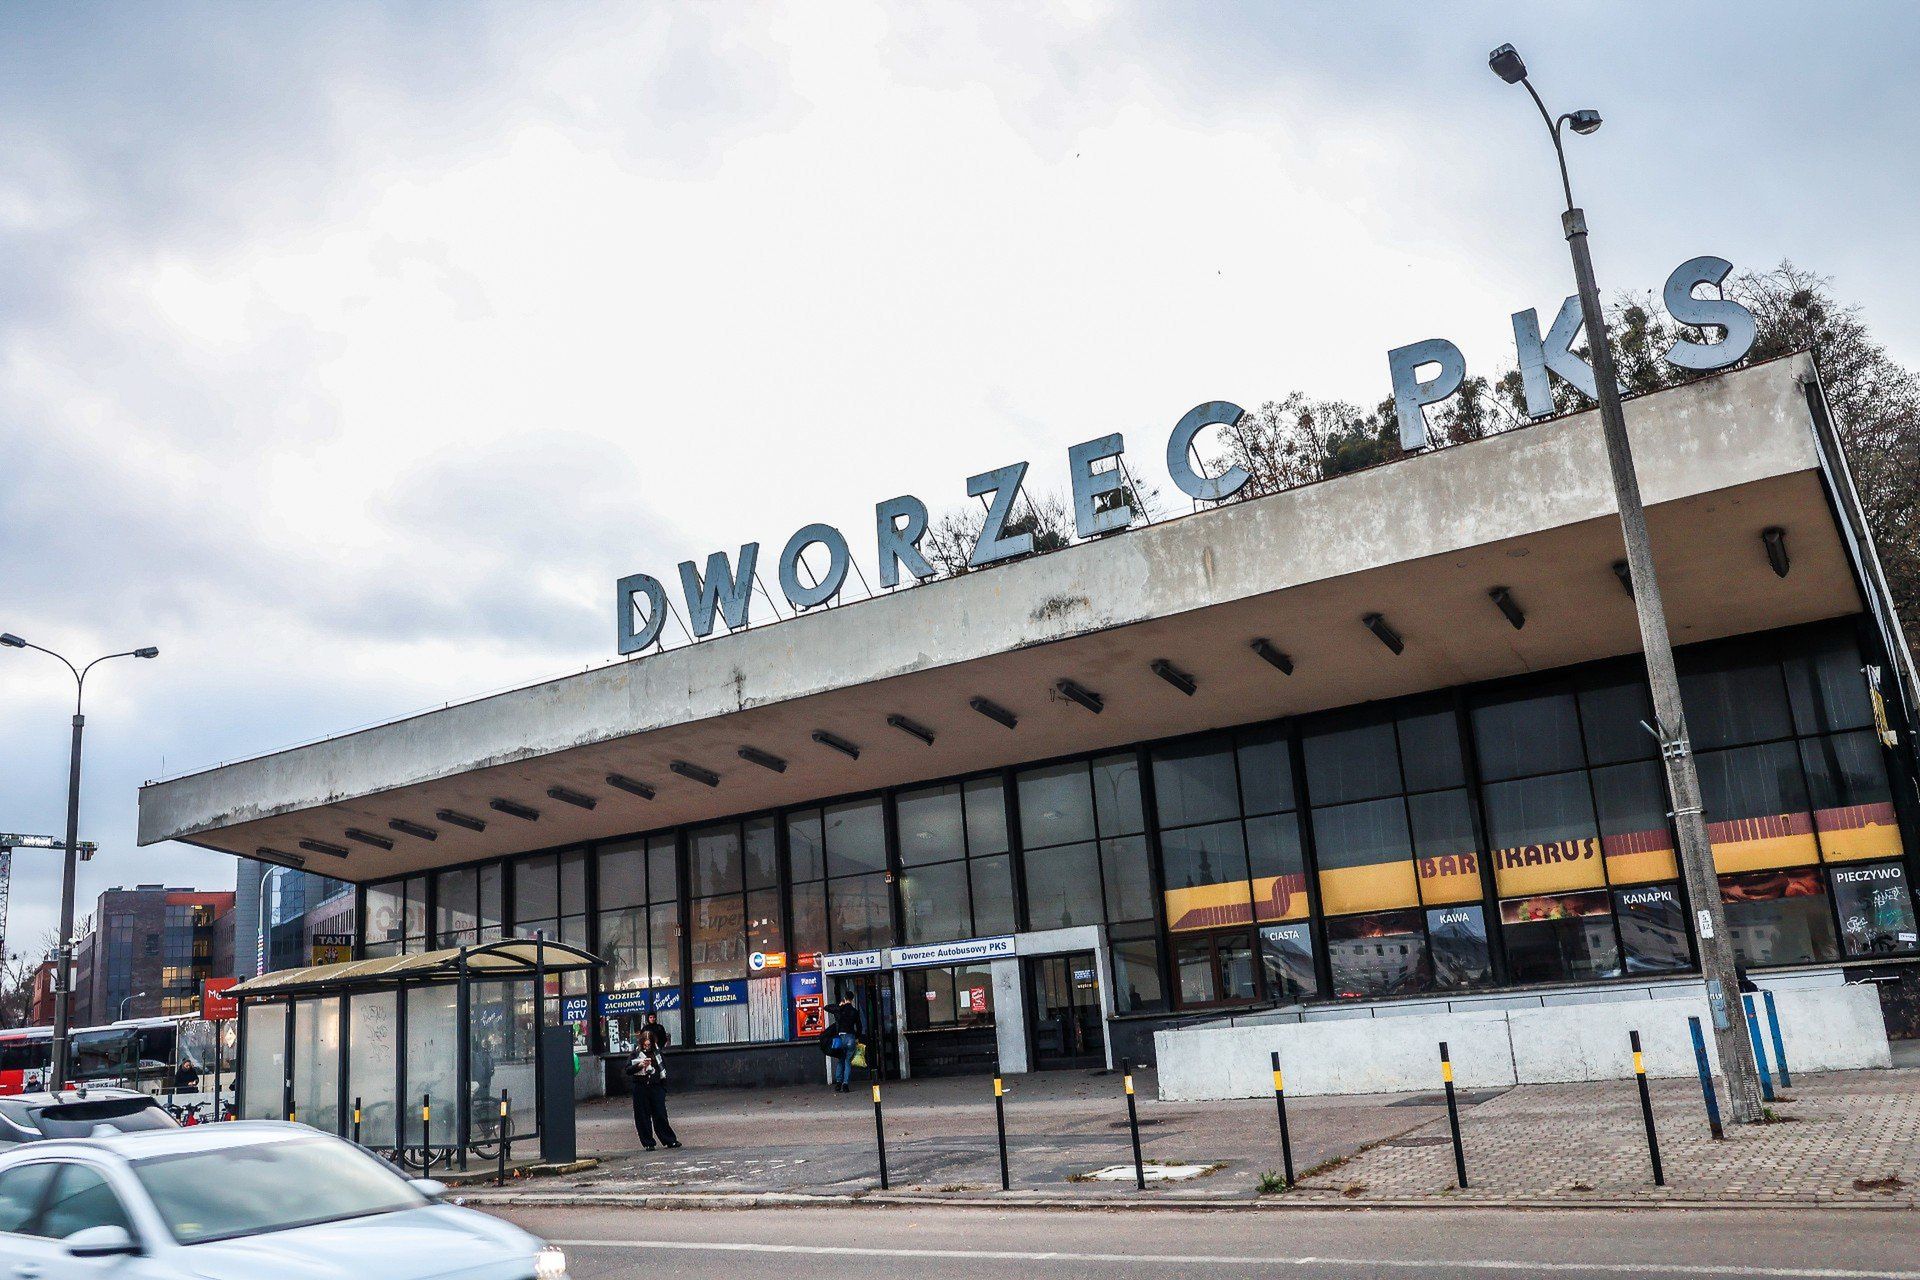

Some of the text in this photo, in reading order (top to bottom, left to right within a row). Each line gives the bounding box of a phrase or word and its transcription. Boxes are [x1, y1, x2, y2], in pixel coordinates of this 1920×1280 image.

[616, 255, 1757, 656] DWORZEC PKS
[1419, 837, 1595, 879] BAR IKARUS
[1836, 867, 1901, 883] PIECZYWO
[1623, 891, 1673, 905] KANAPKI
[1439, 912, 1470, 924] KAWA
[319, 936, 346, 945] TAXI
[1269, 930, 1300, 941] CIASTA
[901, 941, 1007, 961] Dworzec Autobusowy PKS
[827, 955, 875, 968] ul. 3 Maja 12
[608, 991, 641, 1001] ODZIEŻ
[567, 1000, 588, 1009] AGD
[604, 1000, 645, 1010] ZACHODNIA
[567, 1010, 587, 1020] RTV
